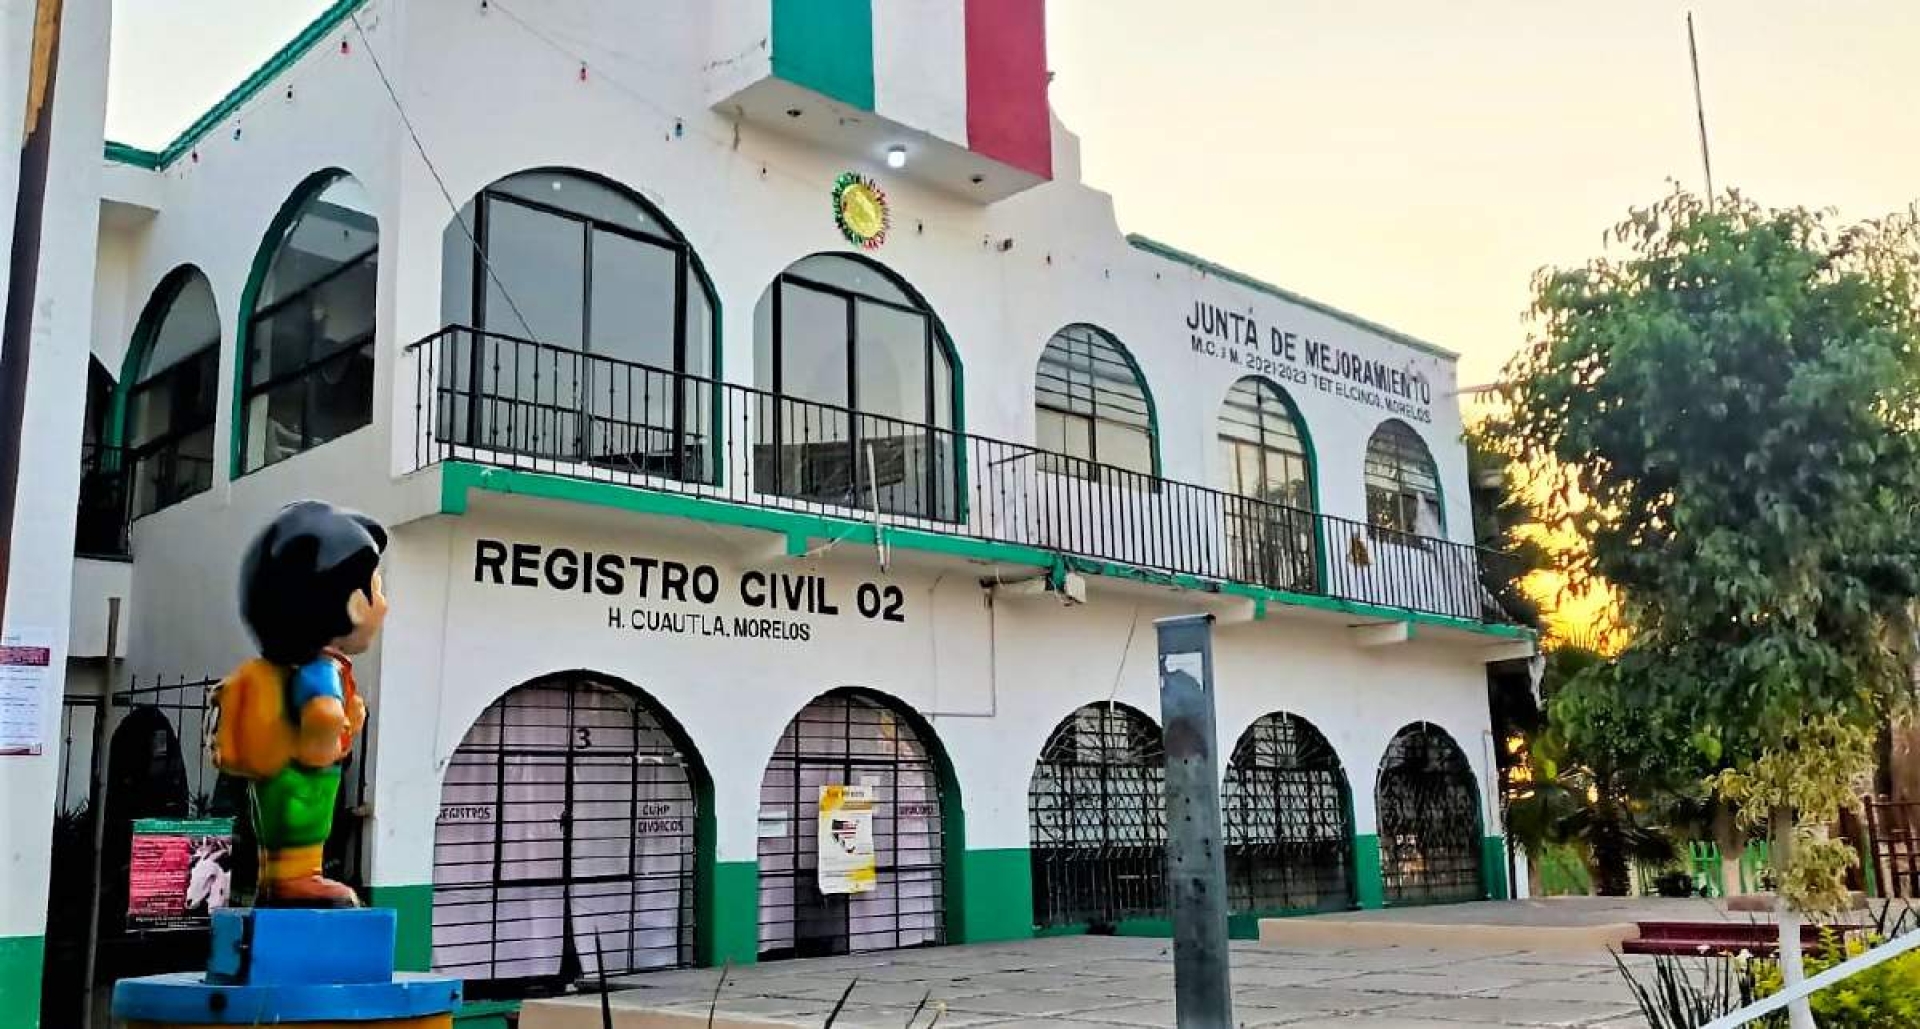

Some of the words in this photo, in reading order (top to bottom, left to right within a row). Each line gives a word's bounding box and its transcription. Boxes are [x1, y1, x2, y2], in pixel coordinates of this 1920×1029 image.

[1271, 326, 1297, 362] DE
[1305, 338, 1431, 406] MEJORAMIENTO
[474, 538, 719, 604] REGISTRO
[740, 569, 839, 616] CIVIL
[857, 583, 905, 622] 02
[608, 606, 626, 629] H.
[734, 617, 811, 642] MORELOS
[575, 728, 592, 750] 3
